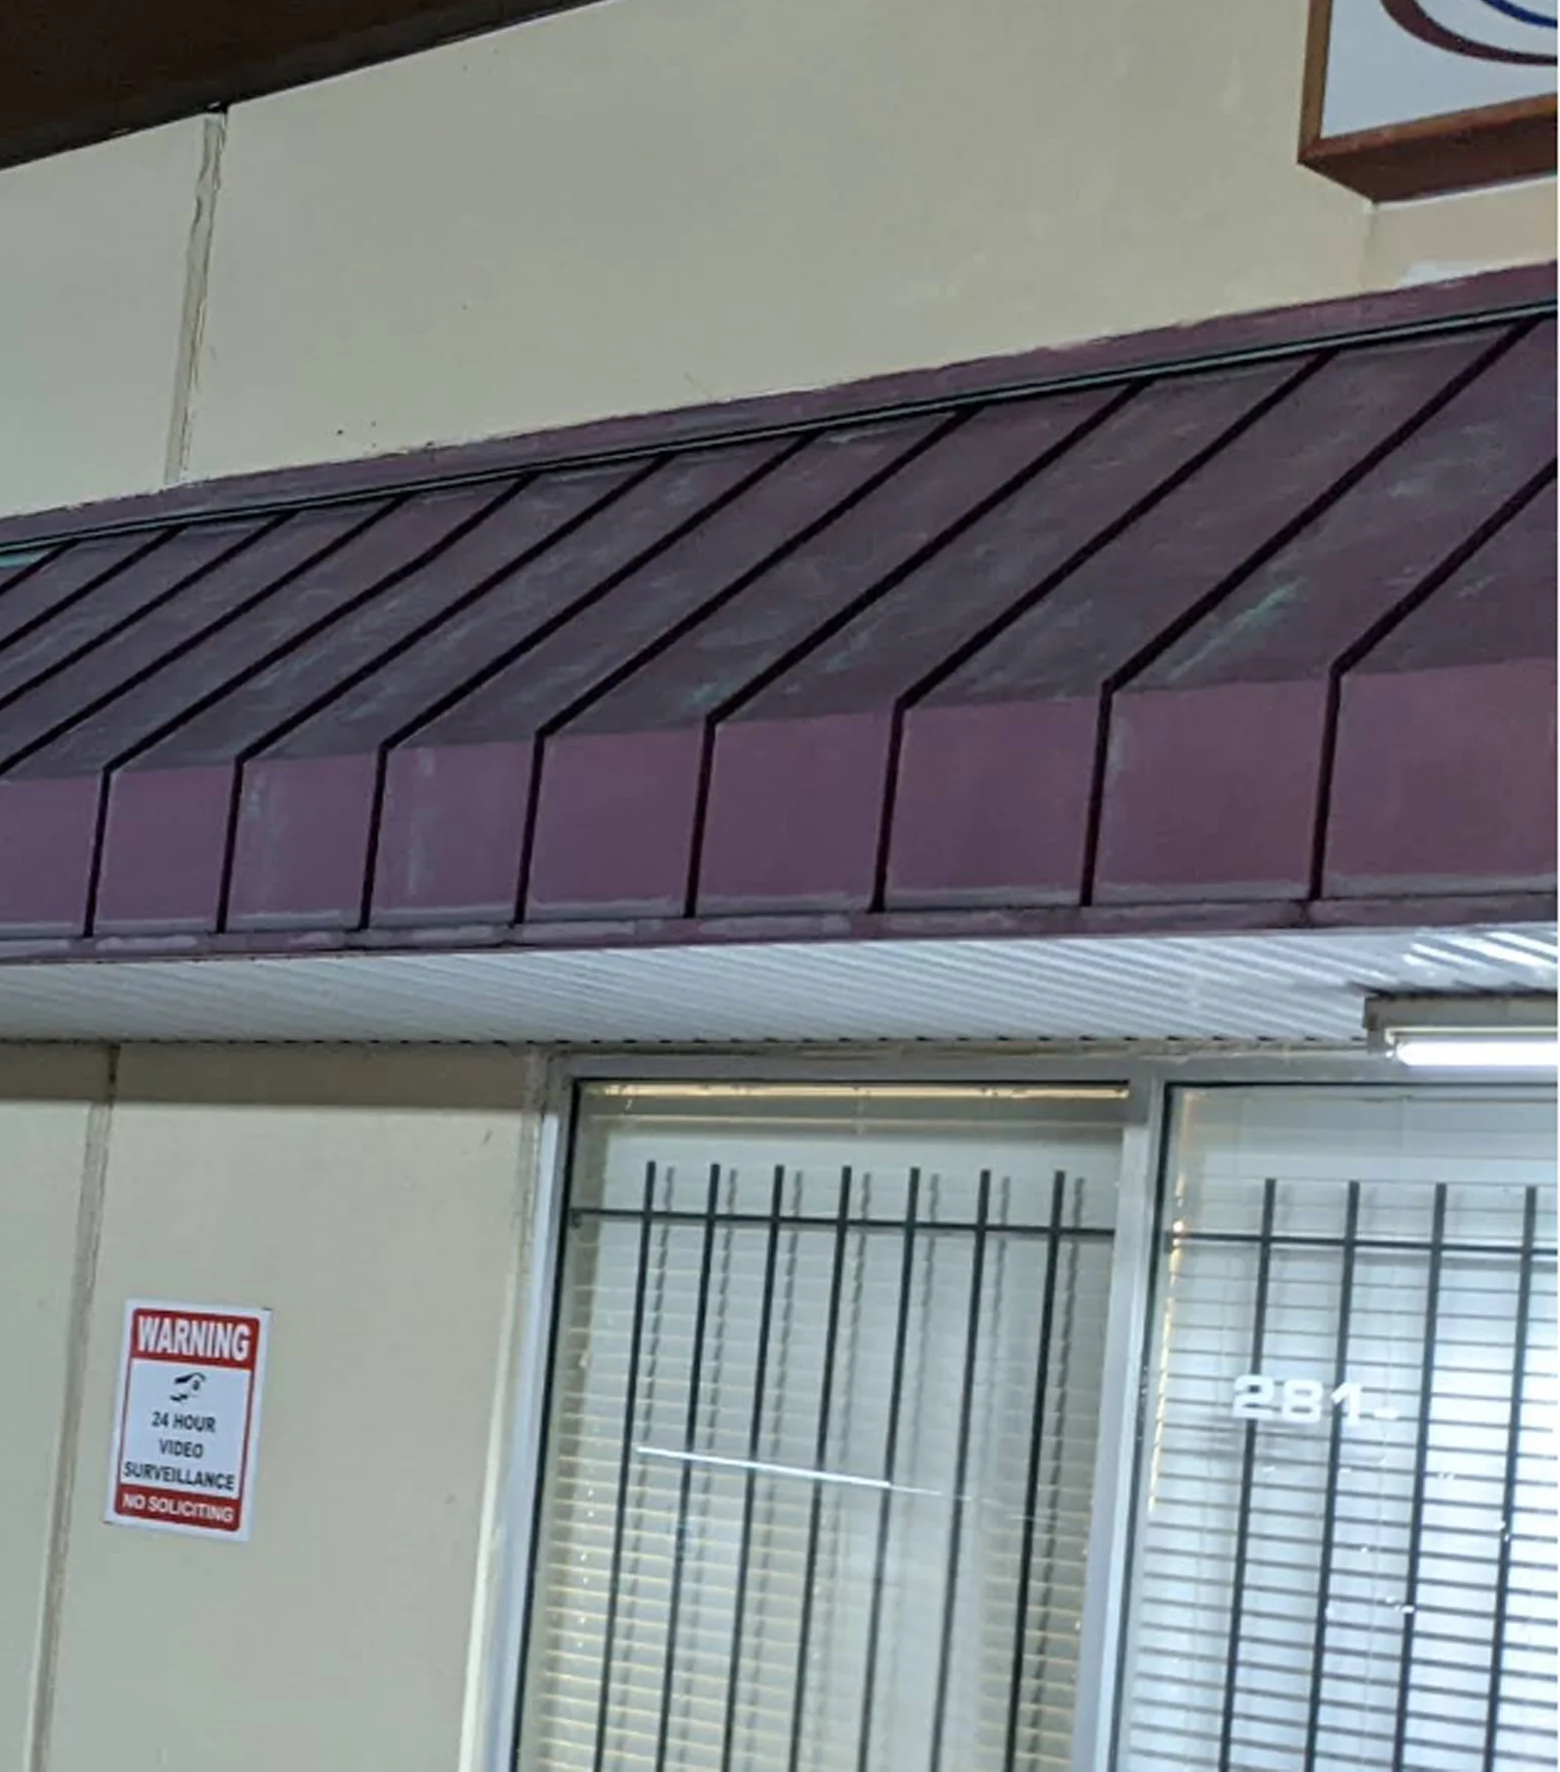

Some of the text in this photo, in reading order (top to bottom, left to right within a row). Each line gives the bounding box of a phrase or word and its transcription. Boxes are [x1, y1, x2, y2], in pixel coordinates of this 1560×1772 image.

[138, 1316, 250, 1360] WARNING
[150, 1410, 216, 1431] 24 HOUR
[159, 1439, 204, 1458] VIDEO
[124, 1461, 235, 1490] SURVEILLANCE
[122, 1493, 234, 1522] NO SOLICITING
